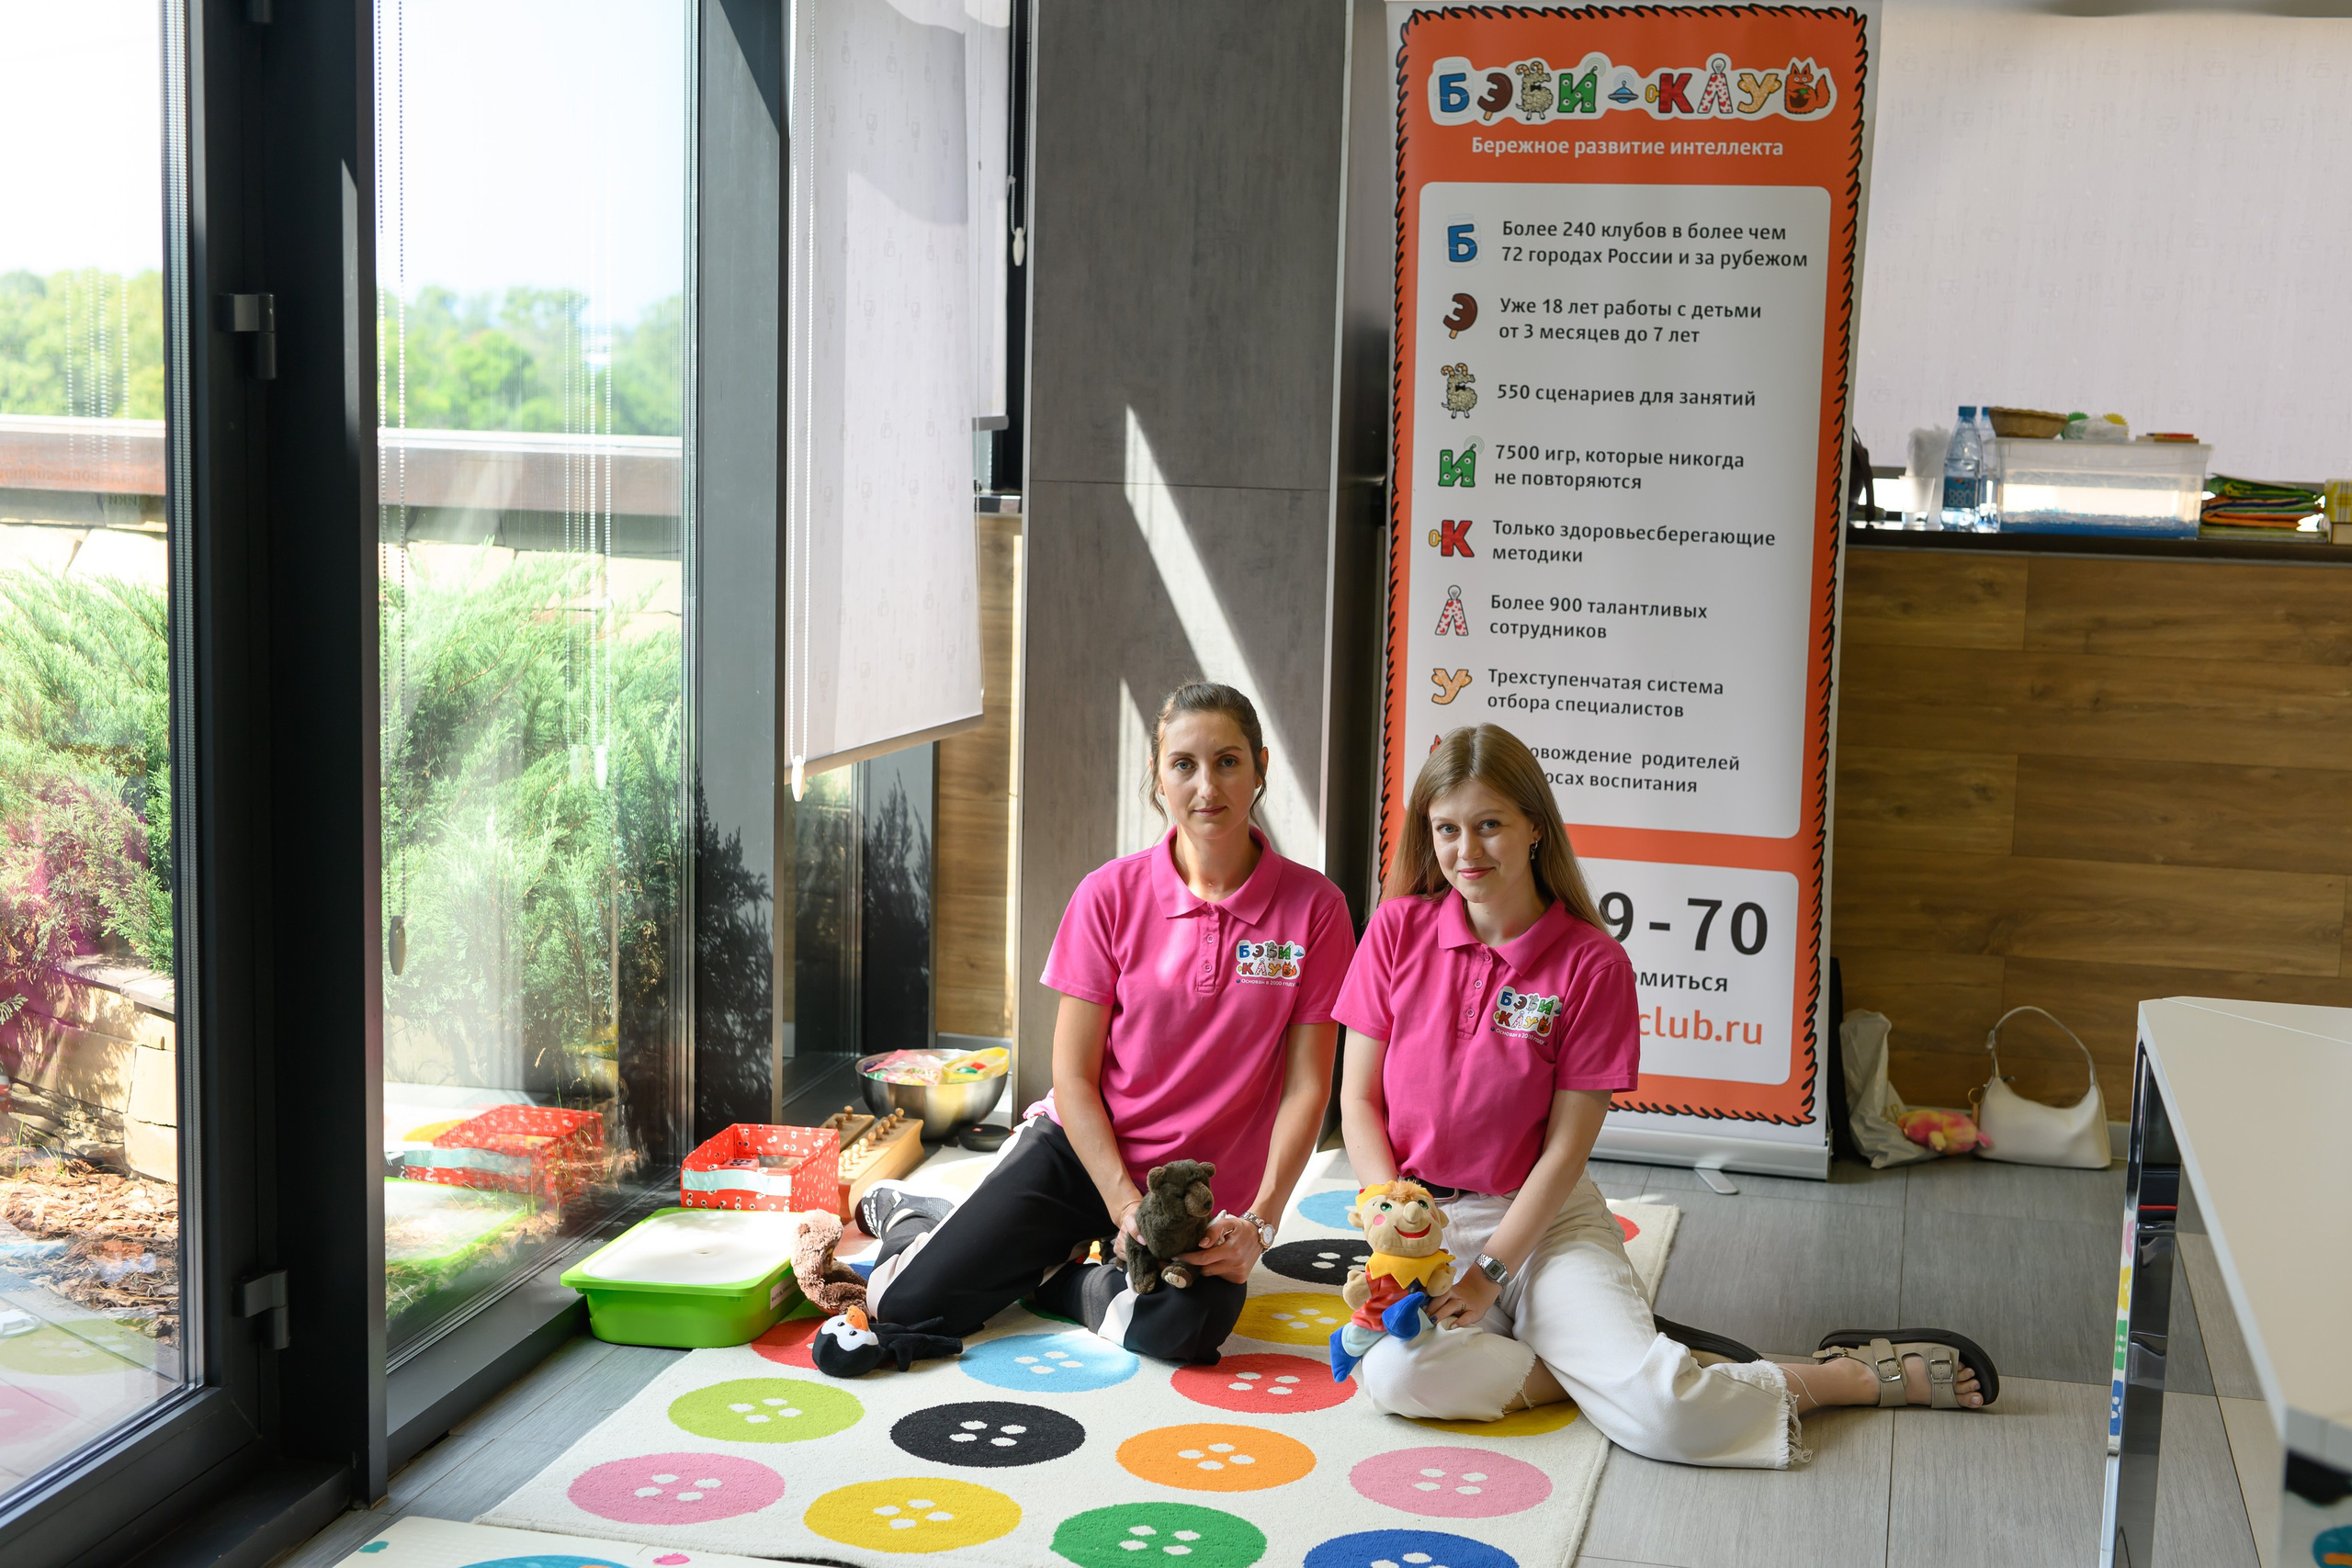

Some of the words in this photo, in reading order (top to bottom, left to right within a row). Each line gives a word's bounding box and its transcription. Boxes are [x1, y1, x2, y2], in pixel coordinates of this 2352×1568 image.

[1438, 60, 1600, 120] БЭБИ
[1471, 136, 1569, 155] Бережное
[1574, 139, 1666, 158] развитие
[1669, 140, 1783, 156] интеллекта
[1502, 220, 1558, 237] Более
[1562, 220, 1596, 238] 240
[1601, 220, 1668, 243] клубов
[1672, 226, 1683, 239] в
[1687, 221, 1744, 240] более
[1748, 227, 1786, 241] чем
[1501, 246, 1523, 262] 72
[1528, 250, 1603, 267] городах
[1608, 247, 1673, 265] России
[1679, 252, 1690, 265] и
[1694, 253, 1714, 265] за
[1720, 249, 1808, 270] рубежом
[1499, 297, 1537, 314] Уже
[1542, 298, 1564, 314] 18
[1566, 301, 1600, 315] лет
[1603, 299, 1672, 320] работы
[1677, 304, 1687, 317] с
[1690, 304, 1761, 321] детьми
[1498, 326, 1520, 339] от
[1523, 323, 1534, 339] 3
[1539, 327, 1621, 344] месяцев
[1623, 329, 1648, 344] до
[1653, 326, 1664, 343] 7
[1668, 330, 1701, 344] лет
[1497, 383, 1531, 400] 550
[1535, 388, 1635, 406] сценариев
[1638, 390, 1674, 407] для
[1679, 390, 1756, 407] занятий
[1495, 444, 1540, 461] 7500
[1544, 448, 1580, 466] игр,
[1585, 450, 1664, 468] которые
[1668, 453, 1745, 471] никогда
[1494, 472, 1517, 485] не
[1521, 473, 1642, 491] повторяются
[1492, 519, 1555, 537] Только
[1559, 525, 1776, 548] здоровьесберегающие
[1492, 547, 1583, 565] методики
[1490, 593, 1544, 612] Более
[1549, 596, 1583, 613] 900
[1587, 601, 1708, 619] талантливых
[1489, 622, 1607, 640] сотрудников
[1487, 668, 1642, 691] Трехступенчатая
[1646, 679, 1724, 695] система
[1487, 693, 1550, 714] отбора
[1555, 699, 1684, 718] специалистов
[1530, 746, 1633, 764] овождение
[1641, 753, 1740, 772] родителей
[1589, 773, 1698, 793] воспитания
[1238, 942, 1292, 962] БЭБИ
[1633, 971, 1728, 993] миться
[1499, 990, 1555, 1016] БЭБИ
[1638, 1006, 1763, 1045] club.ru
